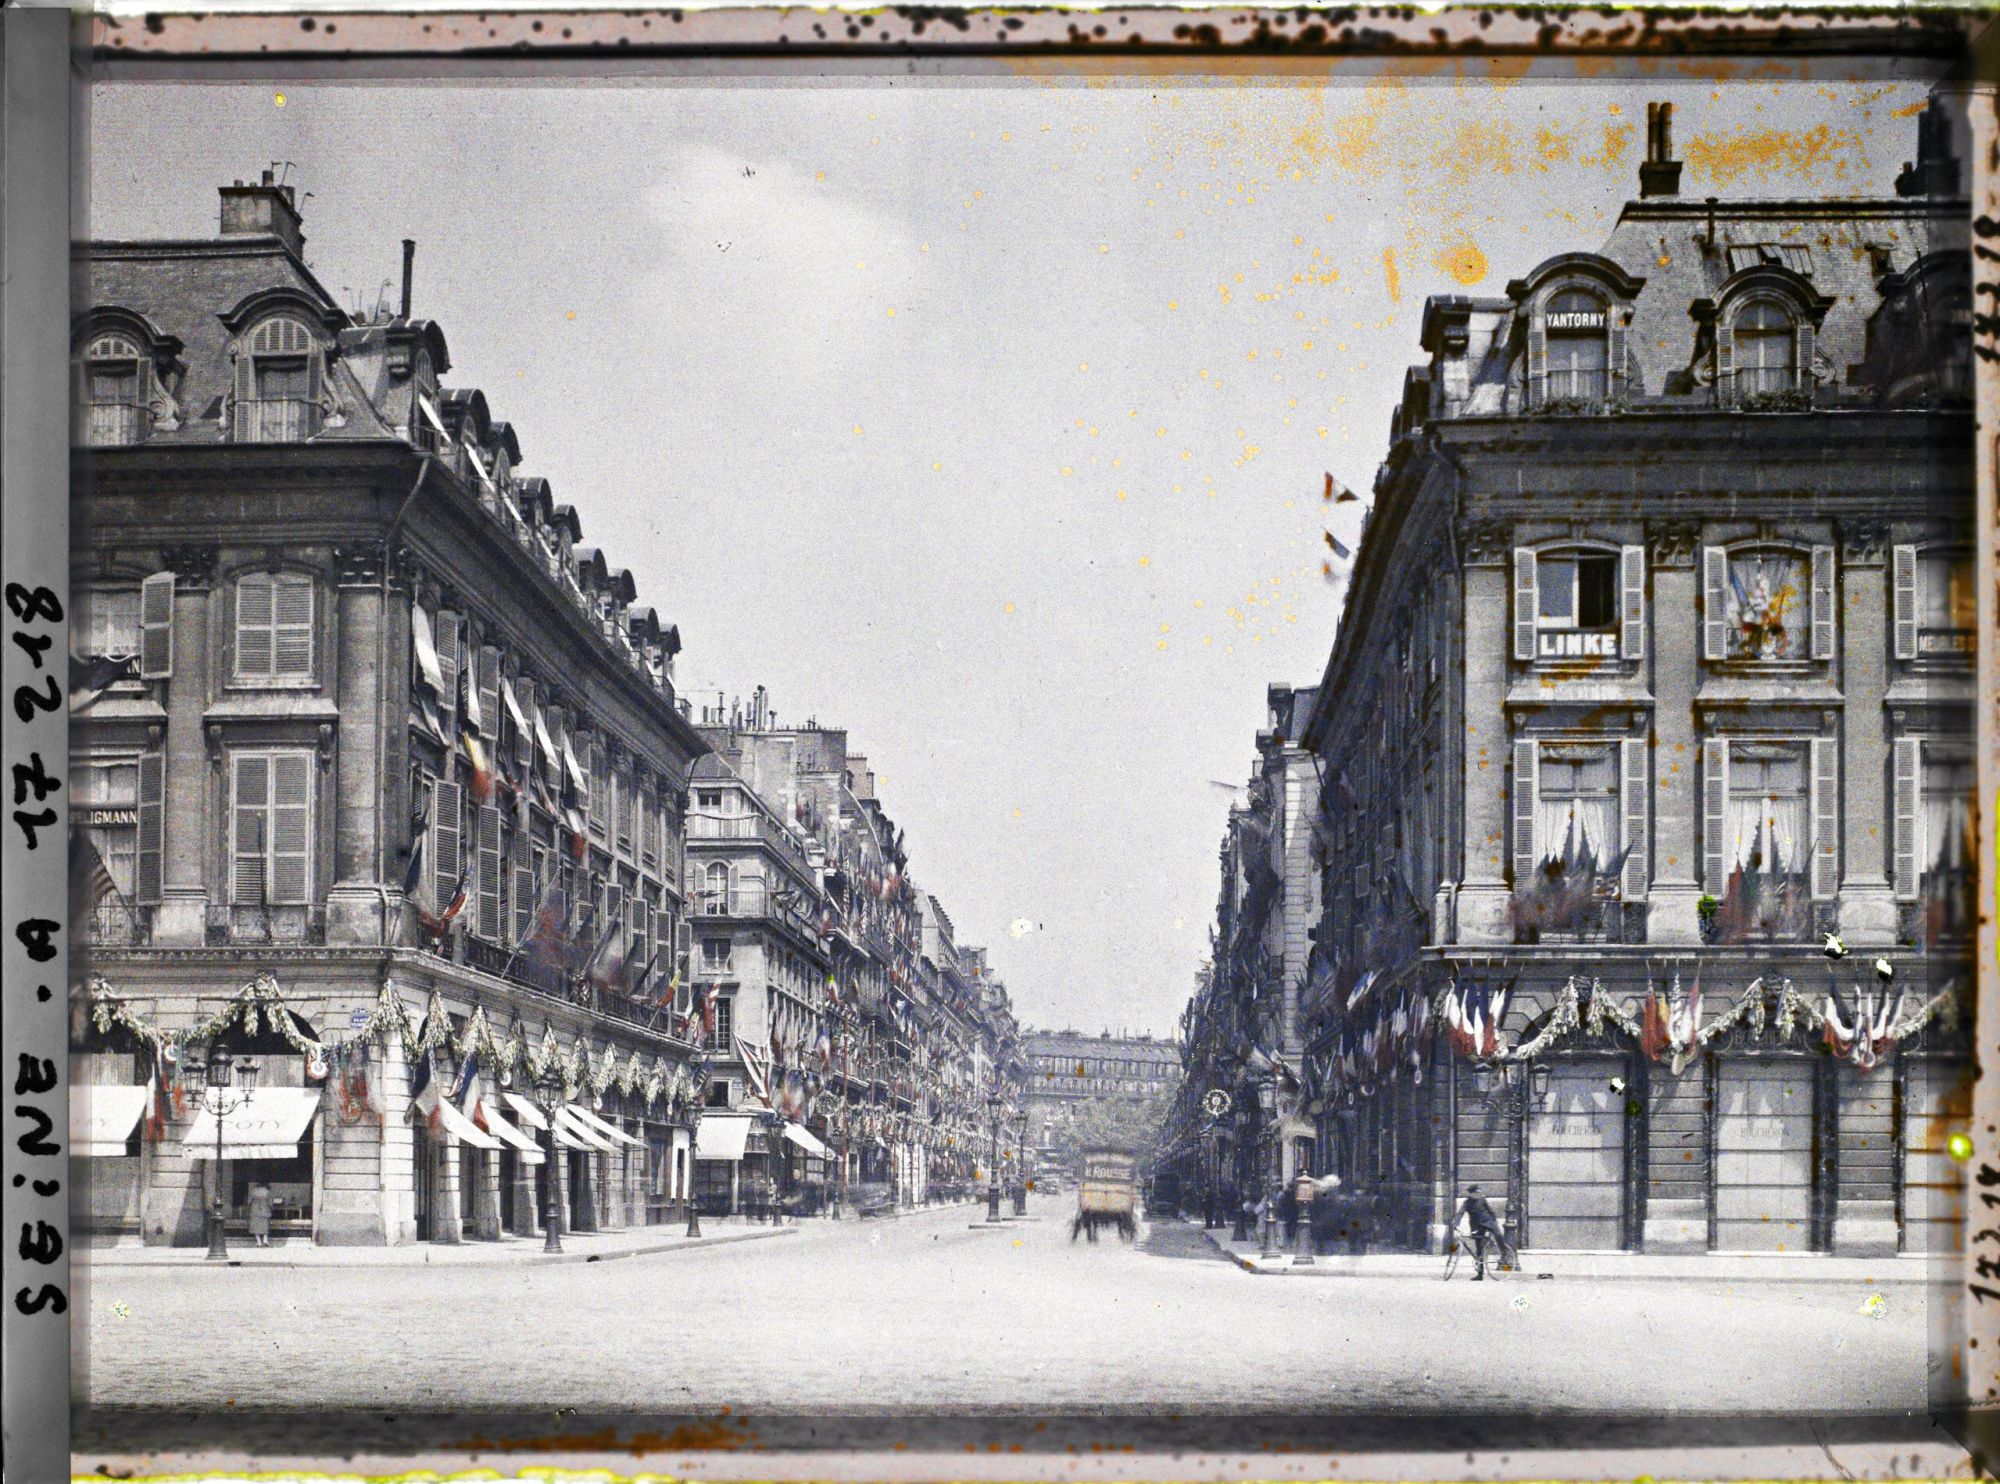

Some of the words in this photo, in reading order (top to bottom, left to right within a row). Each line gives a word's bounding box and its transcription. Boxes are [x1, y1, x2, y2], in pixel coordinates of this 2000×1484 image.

[1546, 312, 1605, 328] YANTORNY
[1540, 633, 1617, 656] LINKE
[215, 1119, 281, 1131] COTY
